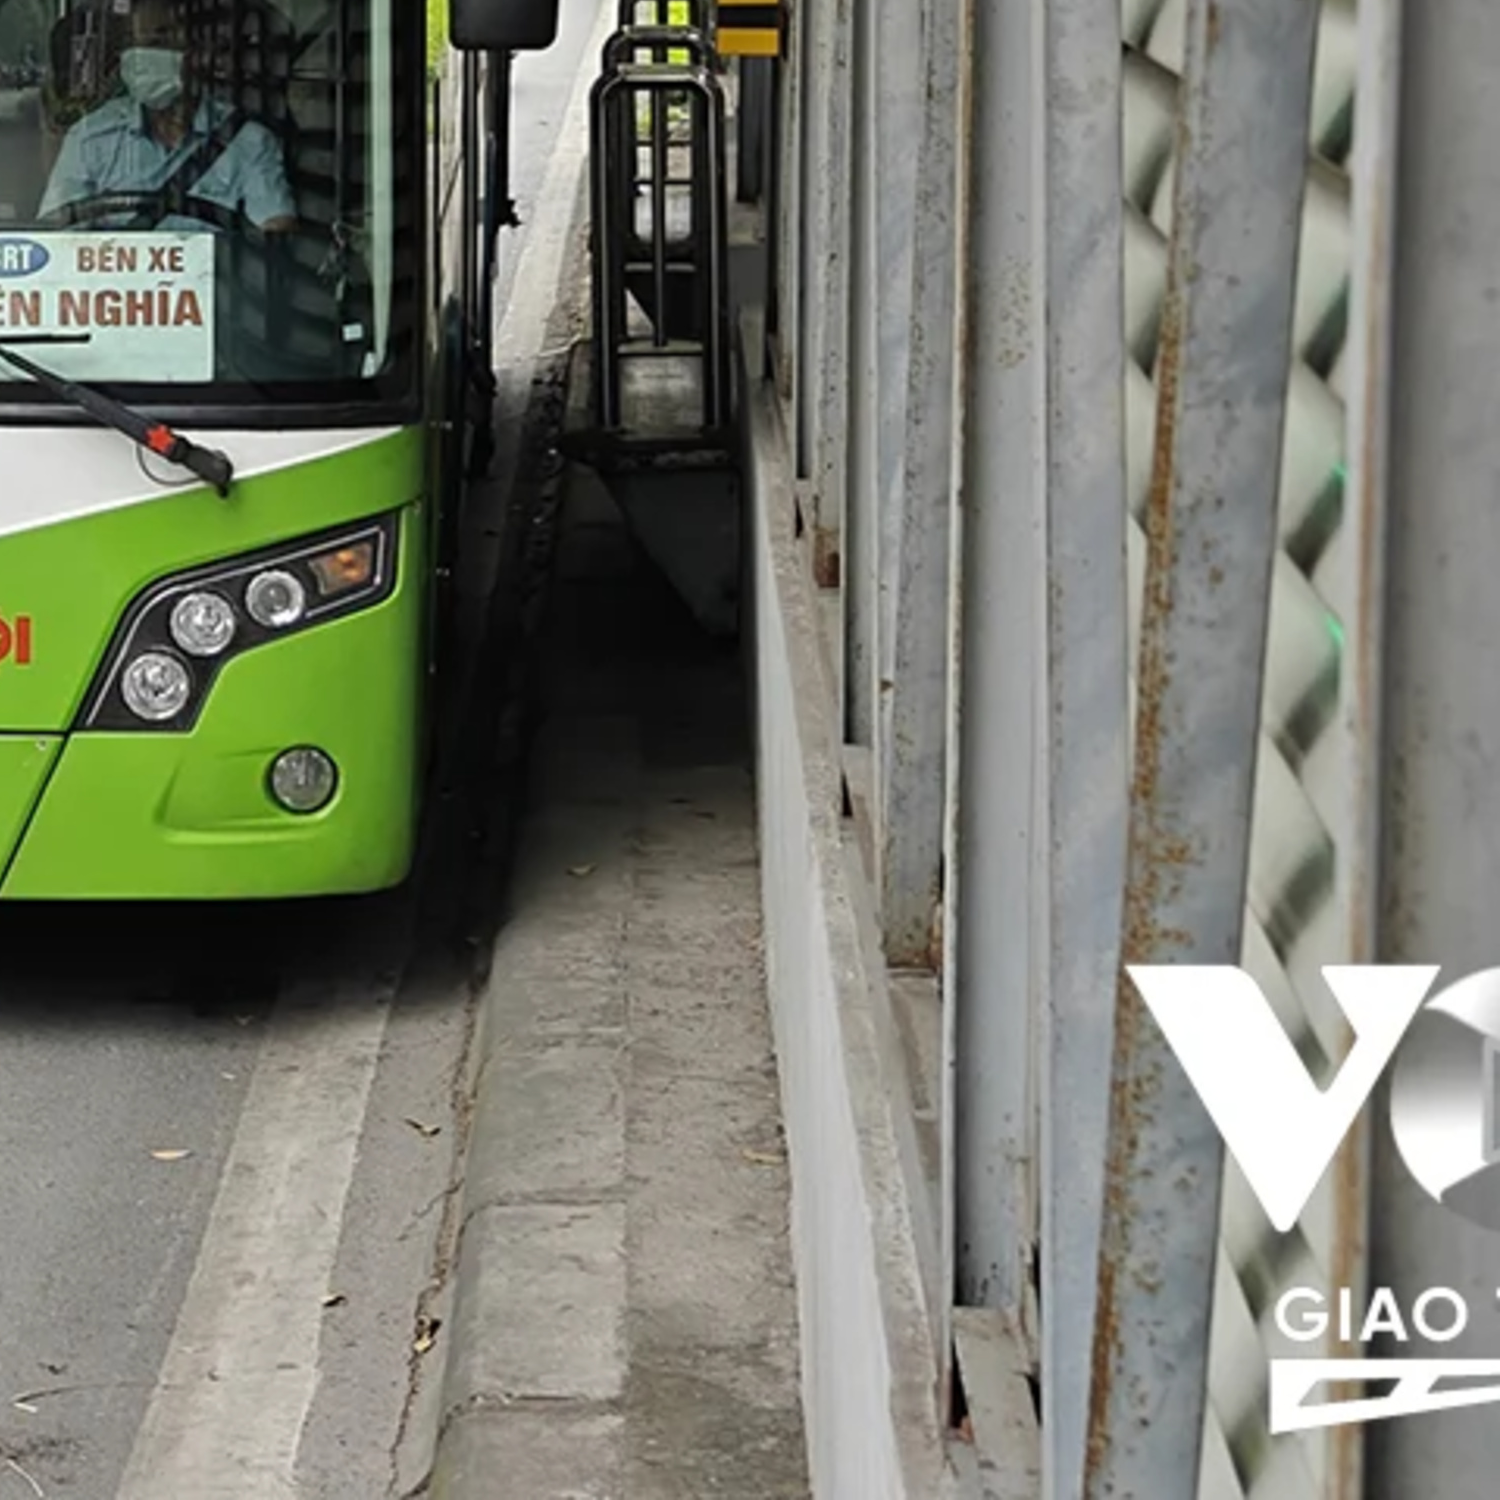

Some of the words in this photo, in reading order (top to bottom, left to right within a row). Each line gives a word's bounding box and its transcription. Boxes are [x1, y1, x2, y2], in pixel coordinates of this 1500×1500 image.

[77, 239, 137, 272] BẾN
[148, 247, 184, 272] XE
[58, 280, 203, 326] NGHĨA
